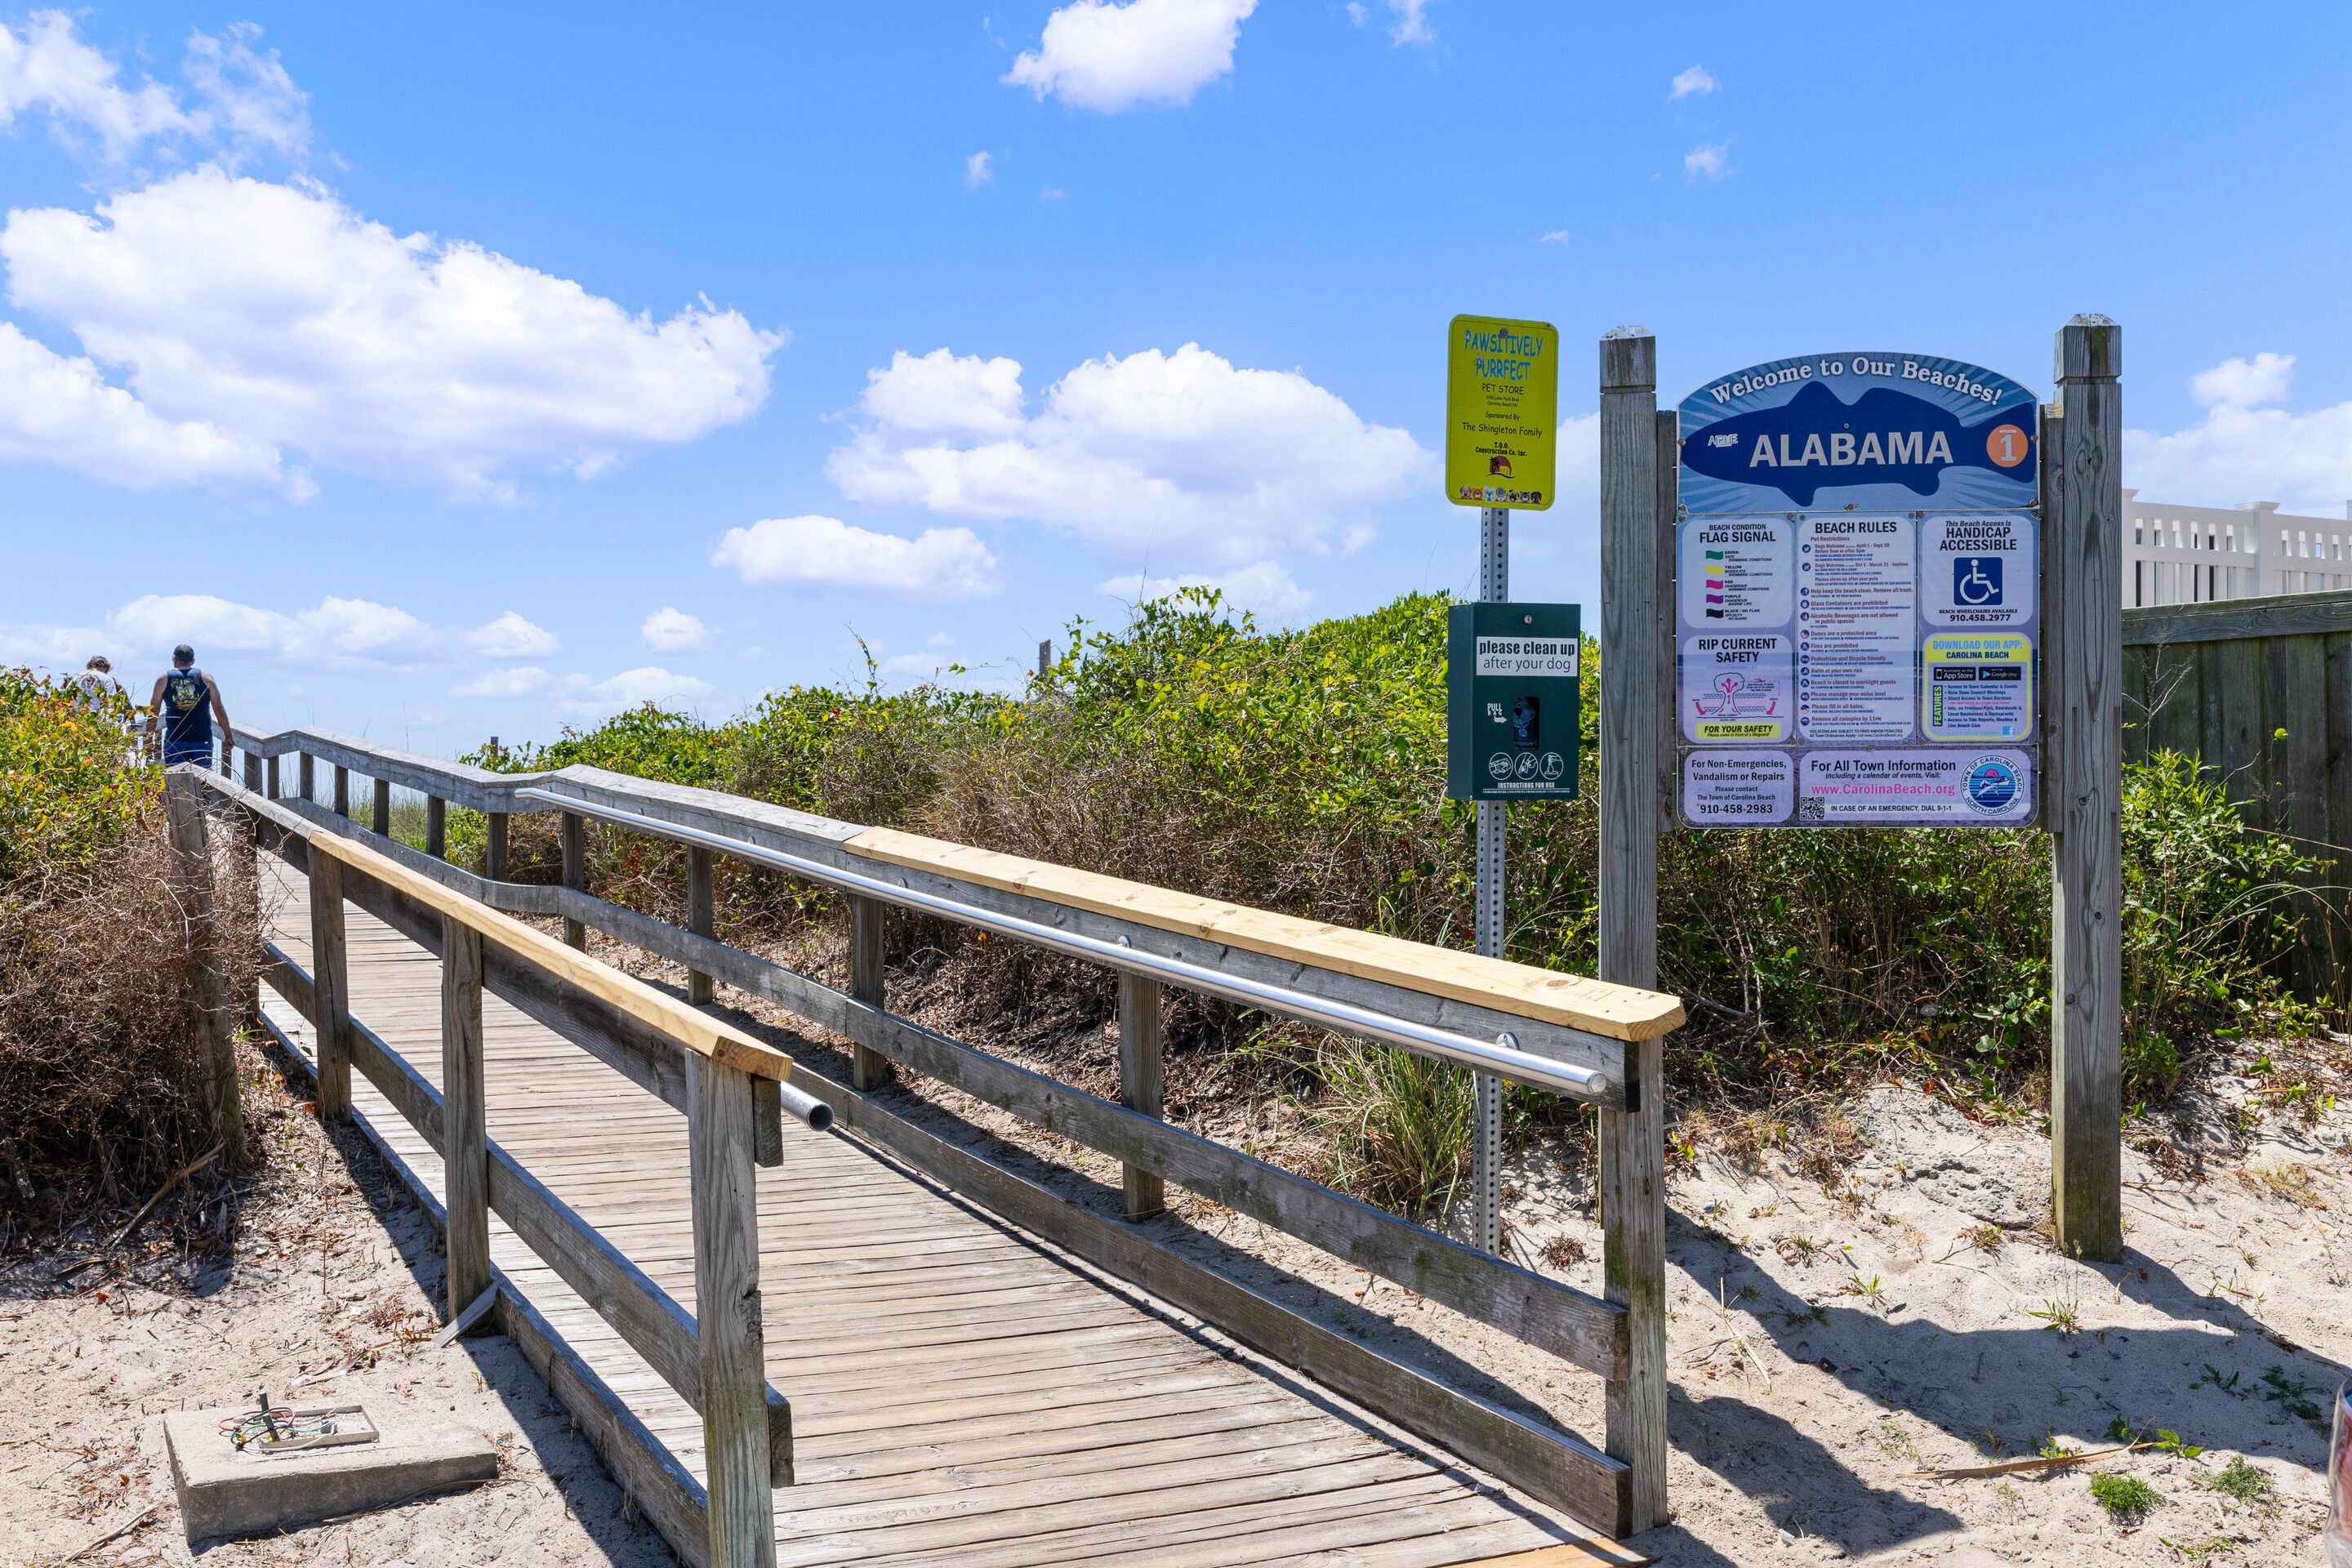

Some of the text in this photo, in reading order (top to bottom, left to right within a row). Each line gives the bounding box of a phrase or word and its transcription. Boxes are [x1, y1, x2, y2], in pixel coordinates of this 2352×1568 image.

[1465, 330, 1543, 357] PAWSITIVELY
[1476, 356, 1530, 381] PURRFECT
[1710, 357, 2003, 405] Welcome to Our Beaches!
[1482, 383, 1524, 394] PET STORE
[1486, 412, 1520, 421] Sponsored By
[1462, 422, 1542, 439] The Shingleton Family
[1476, 447, 1508, 455] Construction
[1749, 431, 1953, 467] ALABAMA
[2000, 434, 2017, 461] 1
[1815, 522, 1897, 533] BEACH RULES
[1946, 527, 2011, 538] HANDICAP
[1699, 532, 1775, 543] FLAG SIGNAL
[1940, 539, 2017, 550] ACCESSIBLE
[1479, 640, 1575, 657] please clean up
[1699, 639, 1777, 649] RIP CURRENT
[1933, 640, 2023, 650] DOWNLOAD OUR APP:
[1716, 652, 1759, 662] SAFETY
[1483, 656, 1570, 673] after your dog
[1487, 703, 1503, 711] PULL
[1691, 760, 1787, 769] For Non-Emergencies,
[1811, 760, 1956, 772] For All Town Information
[1693, 773, 1737, 781] Vandalism
[1751, 773, 1784, 782] Repairs
[1962, 756, 2022, 792] TOWN OF CAROLINA BEACH
[1811, 784, 1955, 796] www.CarolinaBeach.org
[1700, 804, 1773, 814] 910-458-2983
[1965, 796, 2020, 814] NORTH CAROLINA
